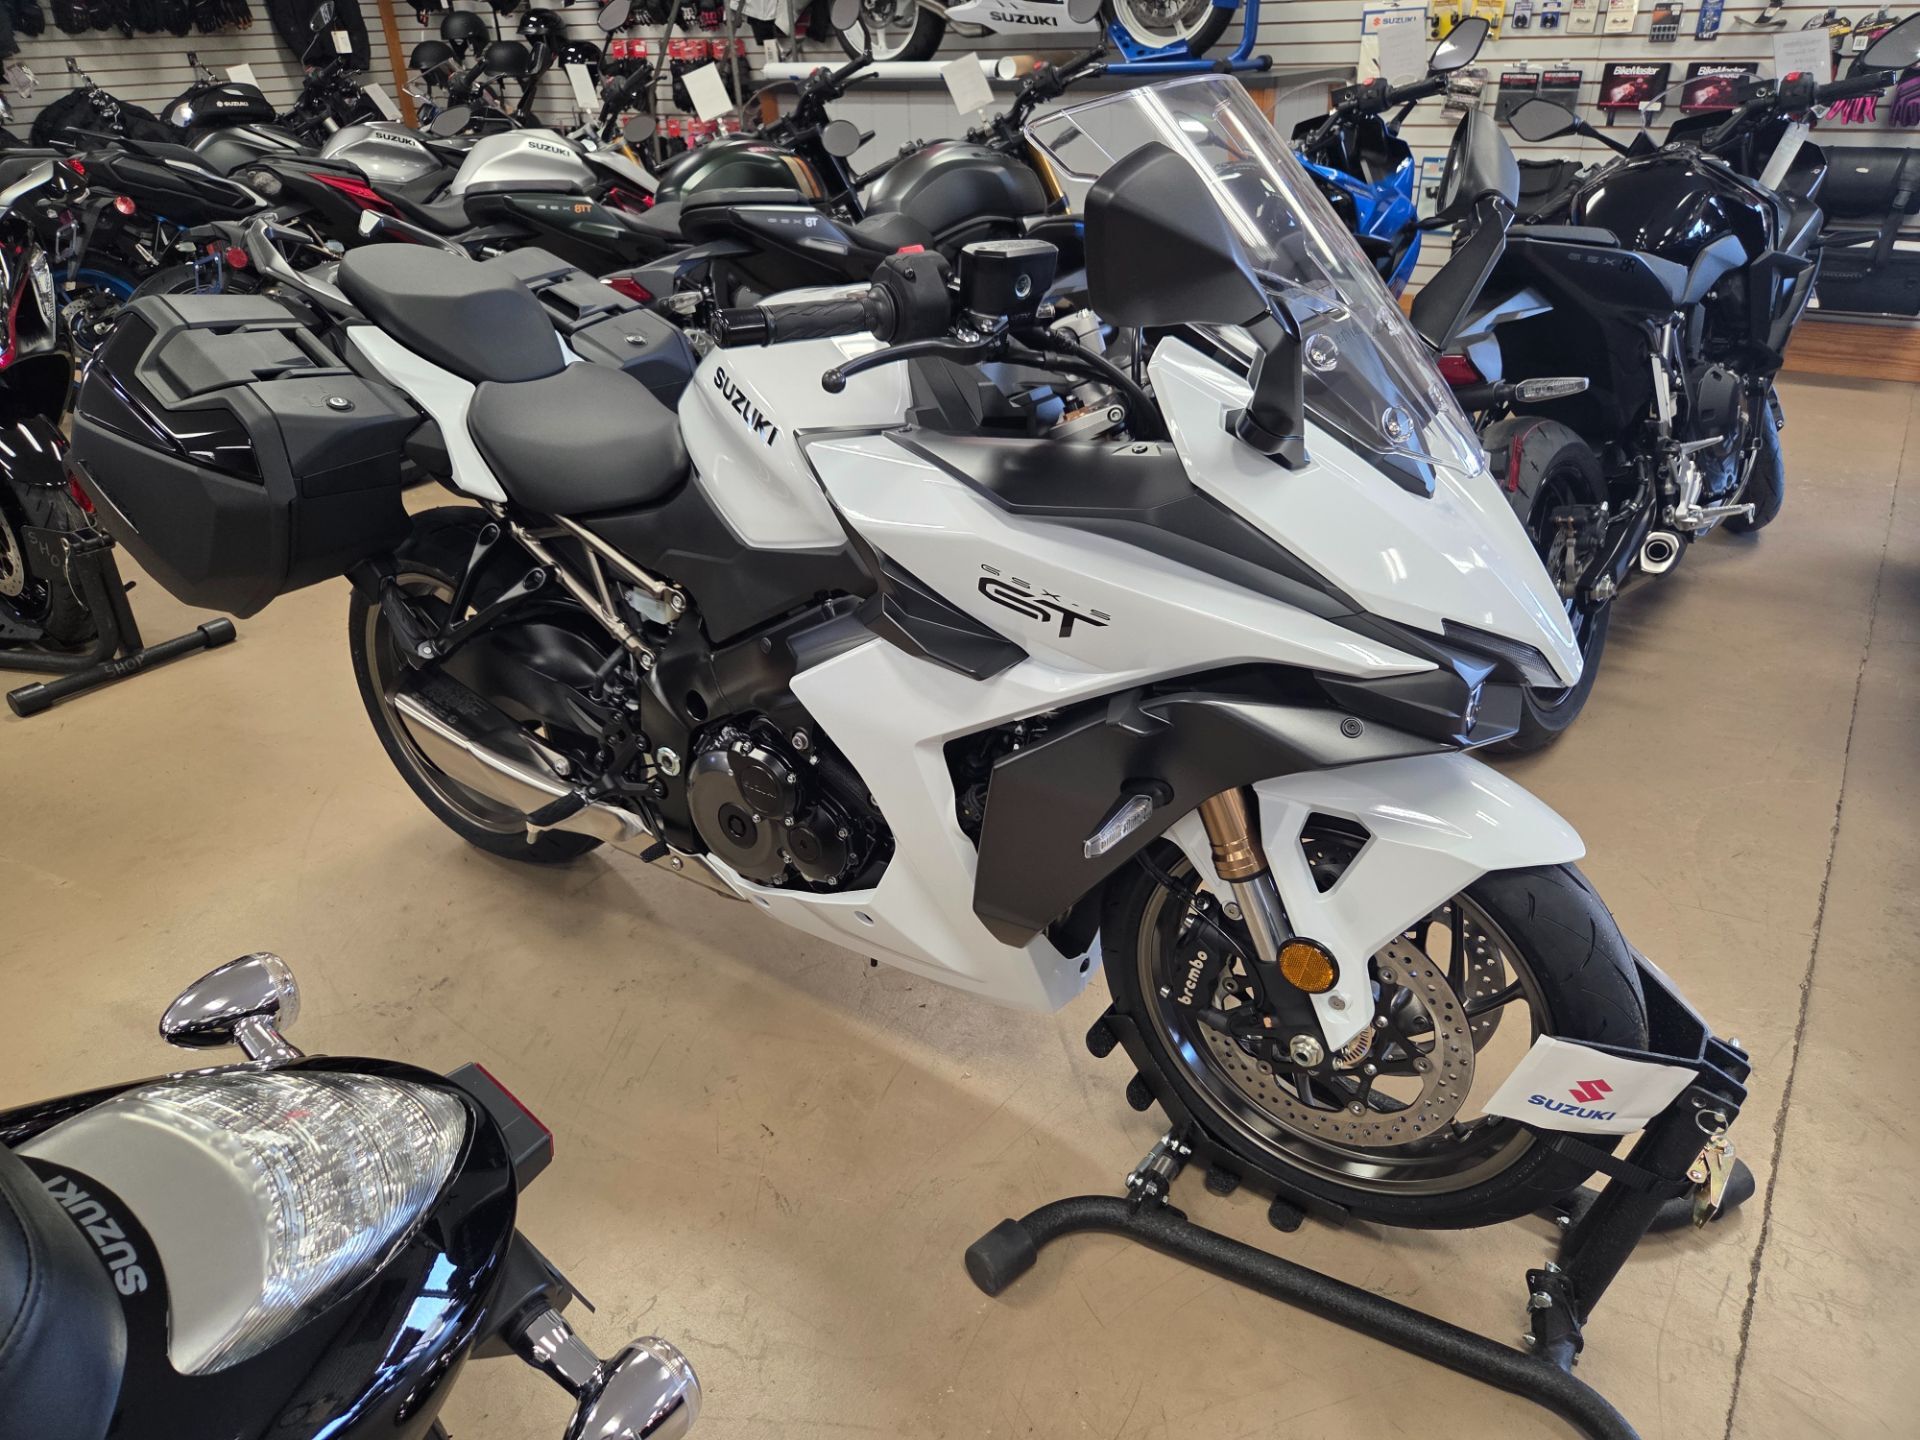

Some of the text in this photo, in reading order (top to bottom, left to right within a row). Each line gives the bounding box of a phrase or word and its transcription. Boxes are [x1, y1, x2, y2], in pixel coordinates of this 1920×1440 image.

[990, 11, 1058, 26] SUZUKI
[1382, 16, 1416, 24] SUZUKI
[375, 132, 416, 146] SUZUKI
[528, 141, 571, 157] SUZUKI
[713, 366, 778, 447] SUZUKI
[978, 577, 1109, 638] GT
[1177, 950, 1208, 1006] brembo
[1527, 1094, 1617, 1121] SUZUKI
[42, 1174, 149, 1296] SUZUKI
